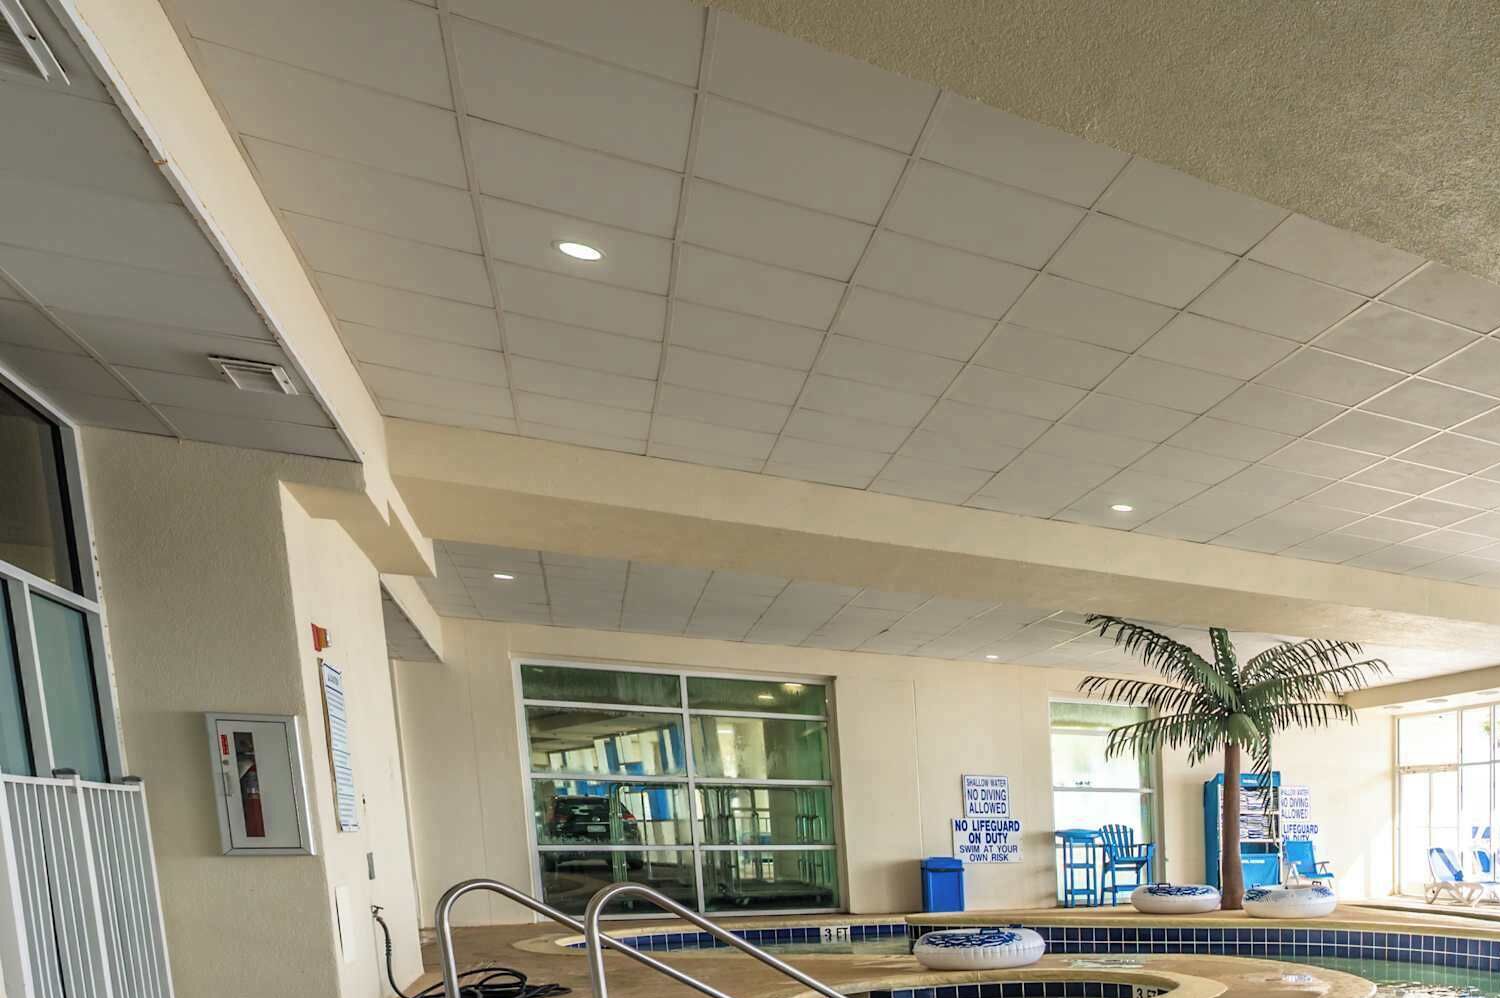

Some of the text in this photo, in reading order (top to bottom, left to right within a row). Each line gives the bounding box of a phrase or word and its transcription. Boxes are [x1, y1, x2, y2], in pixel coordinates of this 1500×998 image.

[966, 779, 1006, 787] SHALLOW WATER
[967, 789, 1007, 801] NO DIVING
[969, 802, 1007, 814] ALLOWED
[1289, 797, 1309, 808] DIVING
[955, 820, 1020, 832] NO LIFEGUARD
[1283, 823, 1319, 834] LIFEGUARD
[968, 833, 1008, 844] ON DUTY
[959, 845, 1018, 853] SWIM AT YOUR
[969, 854, 1009, 862] OWN RISK
[824, 927, 848, 942] 3 FT
